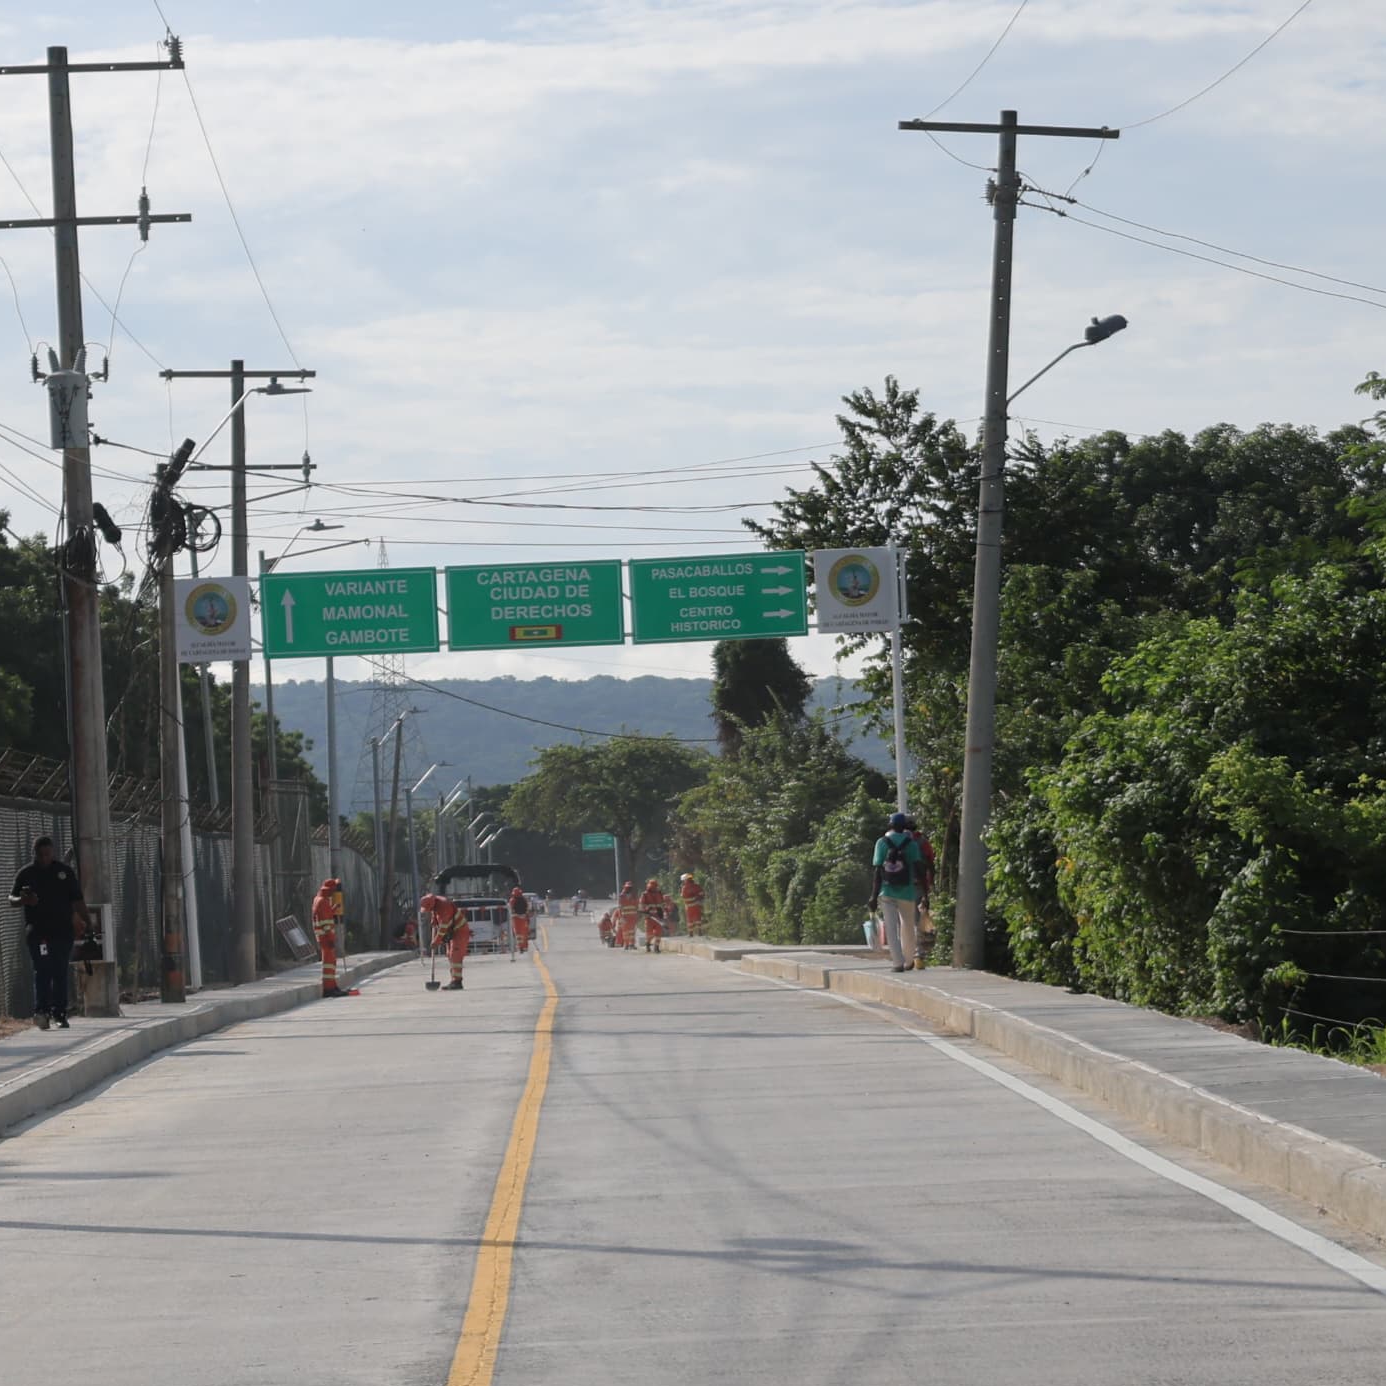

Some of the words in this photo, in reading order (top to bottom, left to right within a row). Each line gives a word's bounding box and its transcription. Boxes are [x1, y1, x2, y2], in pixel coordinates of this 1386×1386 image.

[477, 568, 592, 585] CARTAGENA
[651, 563, 754, 580] PASACABALLOS
[324, 580, 408, 596] VARIANTE
[490, 586, 559, 600] CIUDAD
[565, 584, 590, 597] DE
[669, 588, 686, 599] EL
[689, 585, 746, 598] BOSQUE
[322, 605, 409, 620] MAMONAL
[491, 604, 592, 620] DERECHOS
[679, 606, 734, 618] CENTRO
[671, 619, 742, 632] HISTORICO
[325, 628, 410, 645] GAMBOTE
